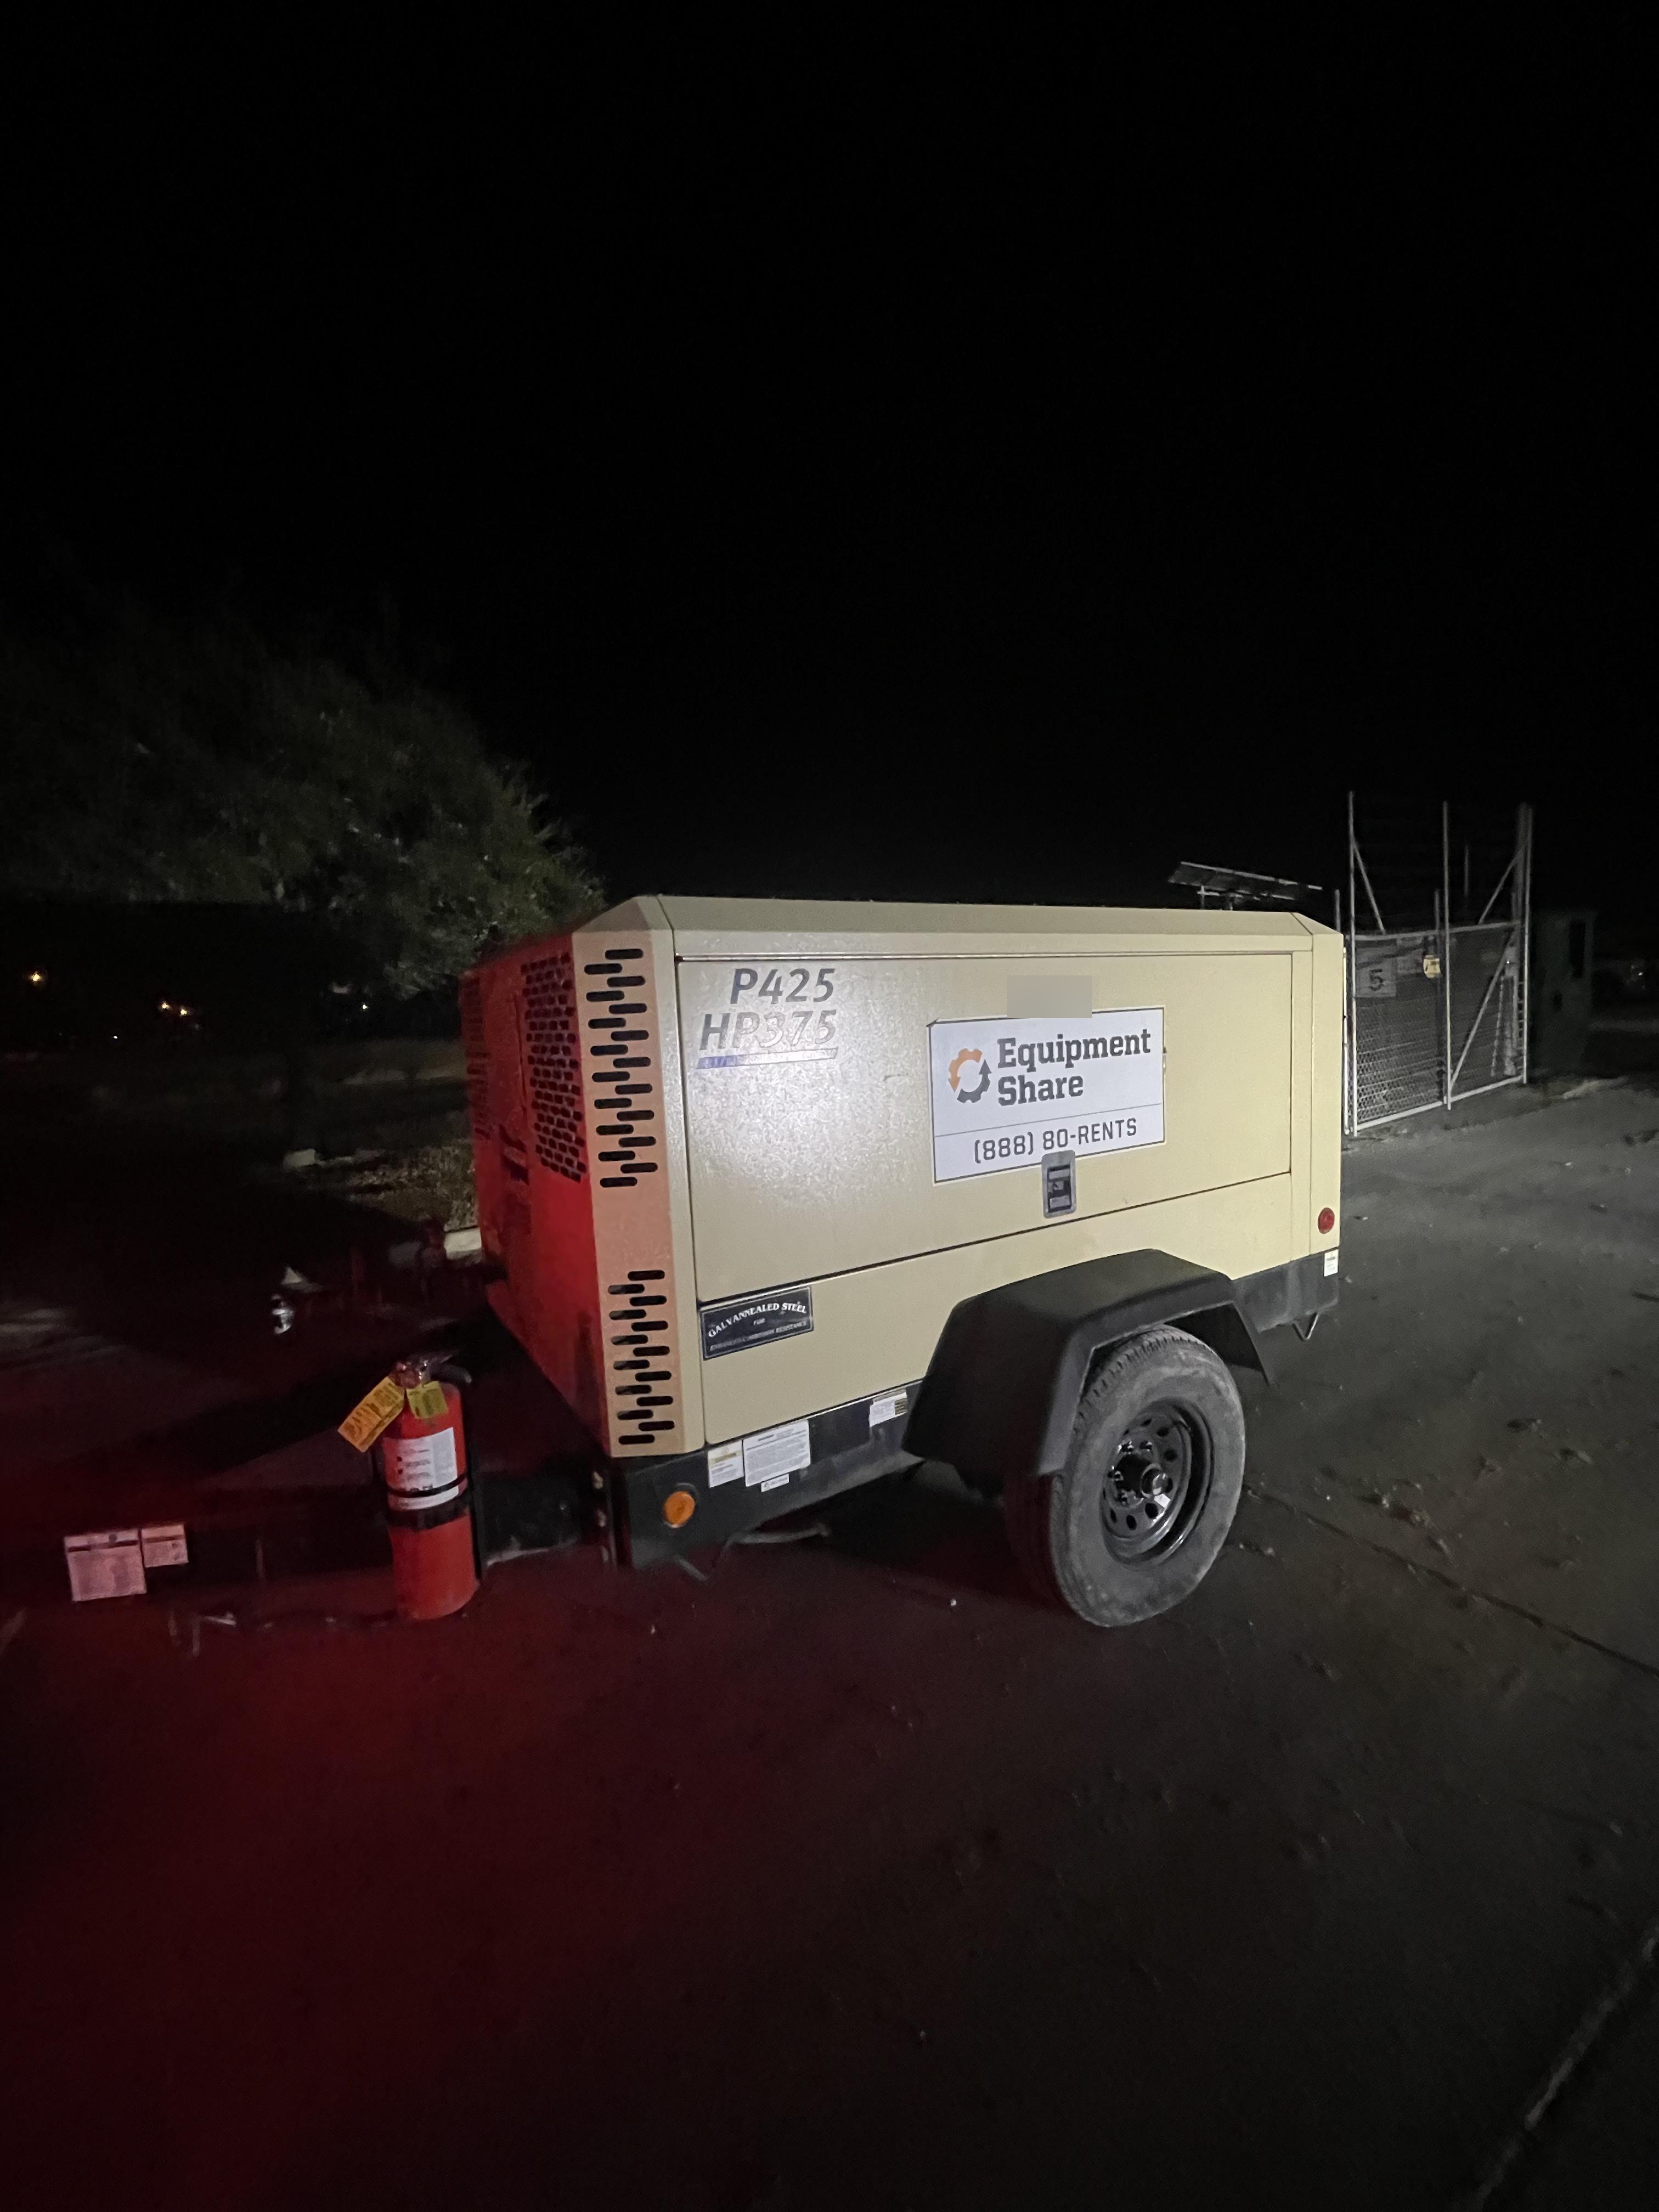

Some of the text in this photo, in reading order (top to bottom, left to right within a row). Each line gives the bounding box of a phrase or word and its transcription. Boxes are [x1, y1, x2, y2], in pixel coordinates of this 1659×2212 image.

[730, 968, 835, 1004] P425
[1369, 968, 1383, 991] 5
[699, 1009, 836, 1050] HP375
[997, 1029, 1151, 1073] Equipment
[997, 1075, 1084, 1106] Share
[974, 1117, 1137, 1164] (888) 80-RENTS
[708, 1302, 806, 1338] GALVANNEALED STEEL
